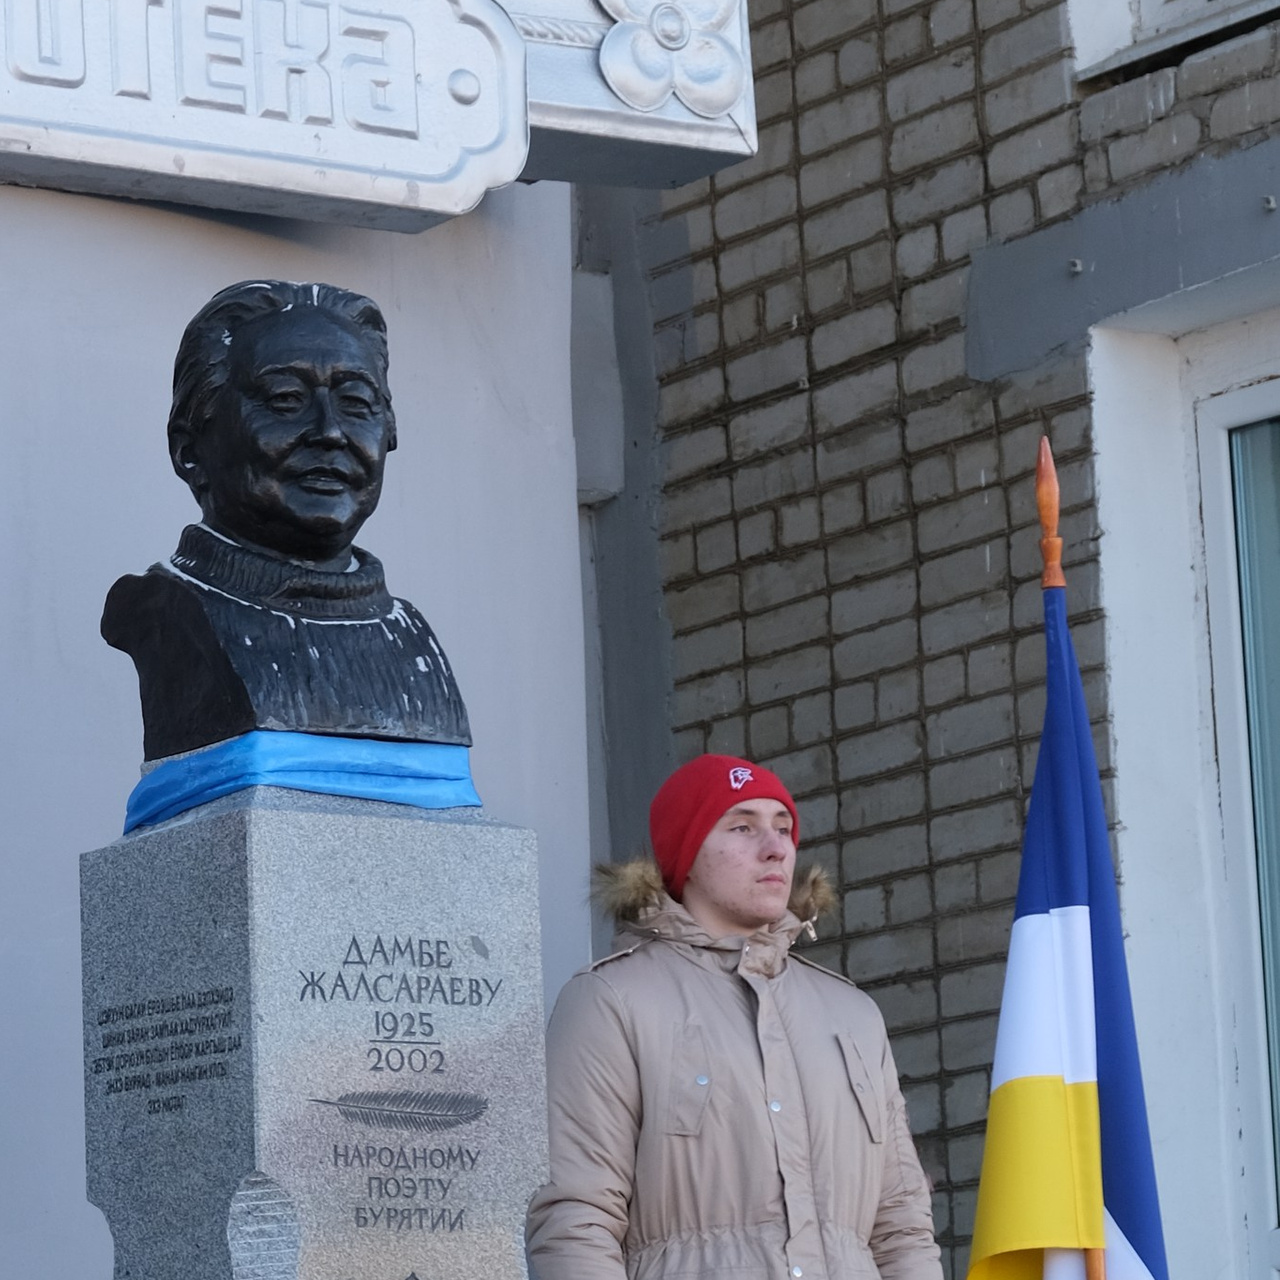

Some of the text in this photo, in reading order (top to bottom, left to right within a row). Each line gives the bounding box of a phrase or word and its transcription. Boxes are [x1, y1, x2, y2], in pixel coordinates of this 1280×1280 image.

[342, 934, 453, 970] ДАМБЕ
[298, 969, 503, 1007] ЖАЛСАРАЕВУ
[374, 1010, 435, 1040] 1925
[367, 1047, 446, 1074] 2002
[332, 1143, 481, 1171] НАРОДНОМУ
[368, 1175, 453, 1201] ПОЭТУ
[354, 1206, 465, 1233] БУРЯТИИ
